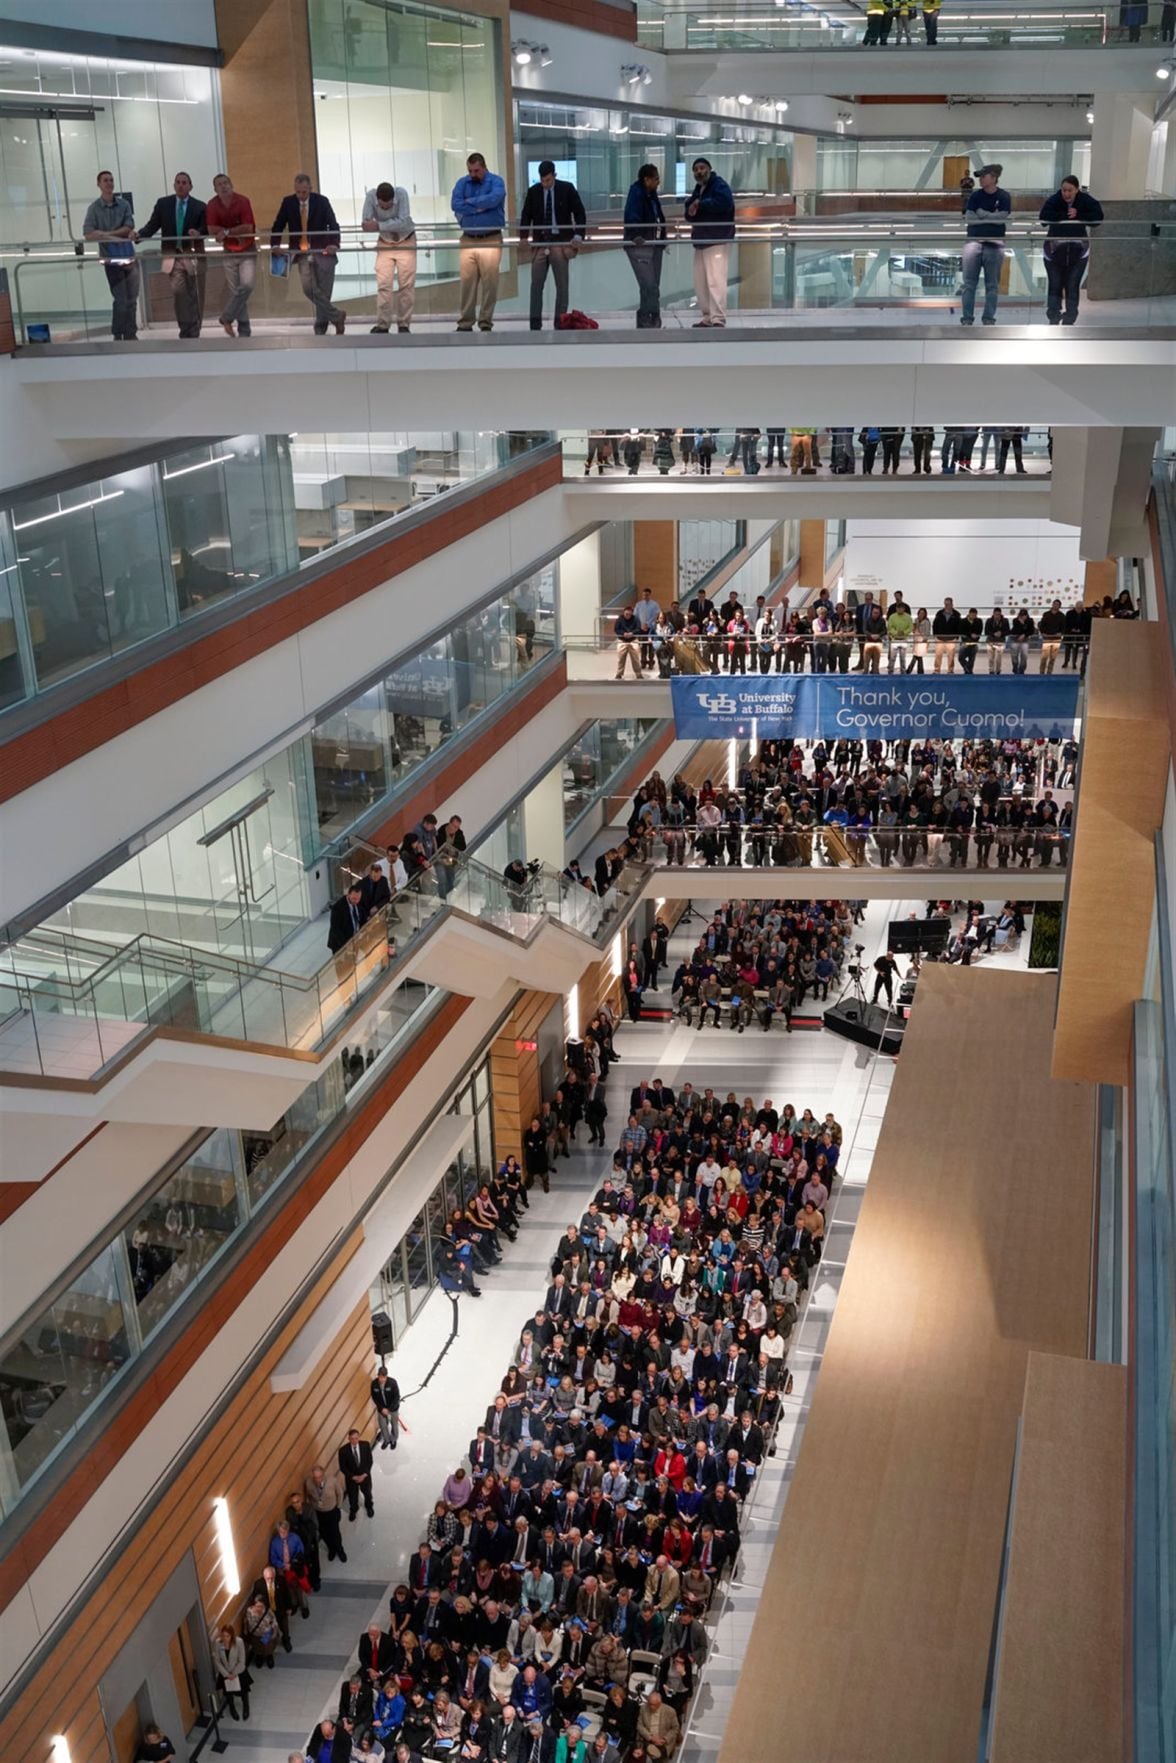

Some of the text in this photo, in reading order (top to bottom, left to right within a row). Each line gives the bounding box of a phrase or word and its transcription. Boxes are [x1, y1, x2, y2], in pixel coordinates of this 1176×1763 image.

[696, 693, 737, 714] UB
[739, 692, 796, 704] University
[836, 686, 951, 710] Thank you,
[741, 704, 794, 714] at Buffalo
[836, 708, 1025, 727] Governor Cuomo!
